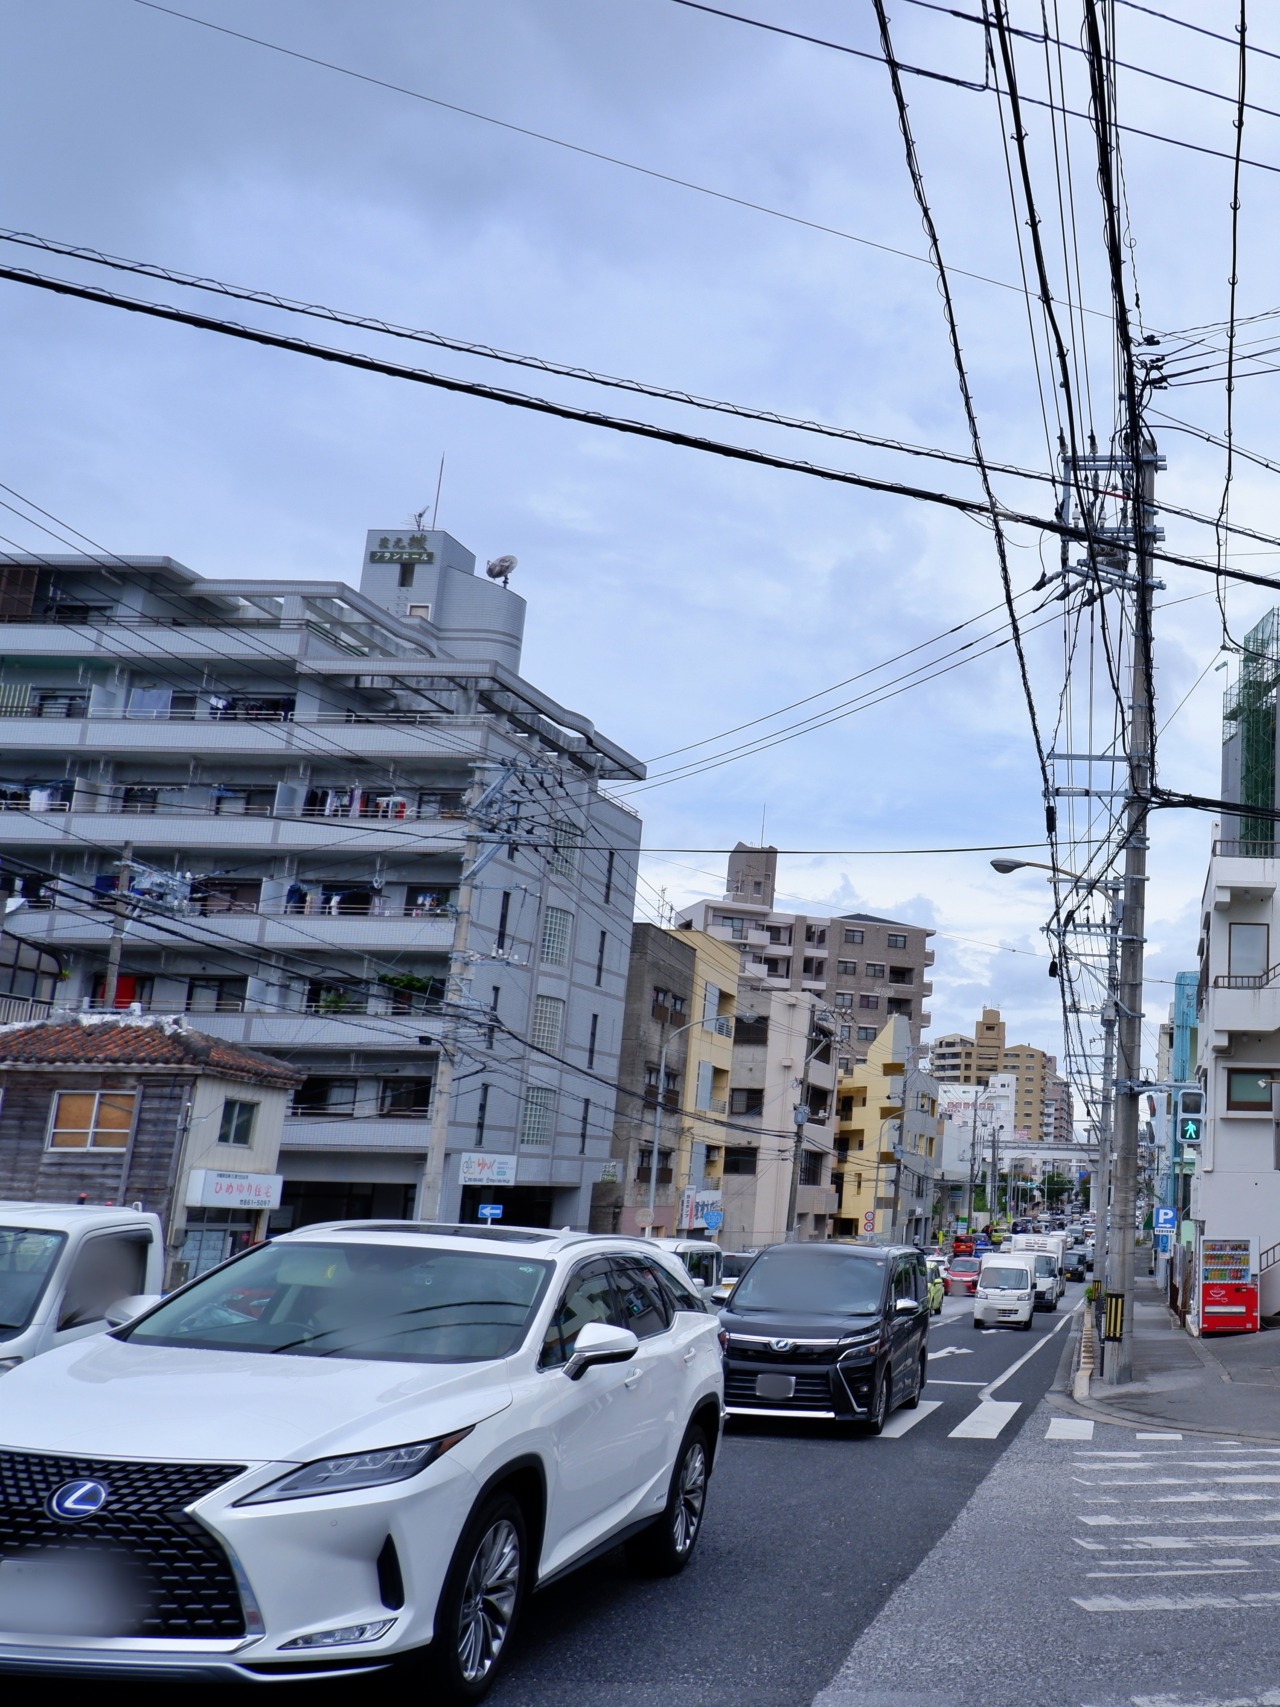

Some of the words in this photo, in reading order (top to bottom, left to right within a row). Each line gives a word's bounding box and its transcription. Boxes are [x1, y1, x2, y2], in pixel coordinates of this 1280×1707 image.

[214, 1181, 272, 1198] ひめゆり住宅
[706, 1215, 720, 1223] 330
[1158, 1209, 1174, 1223] P
